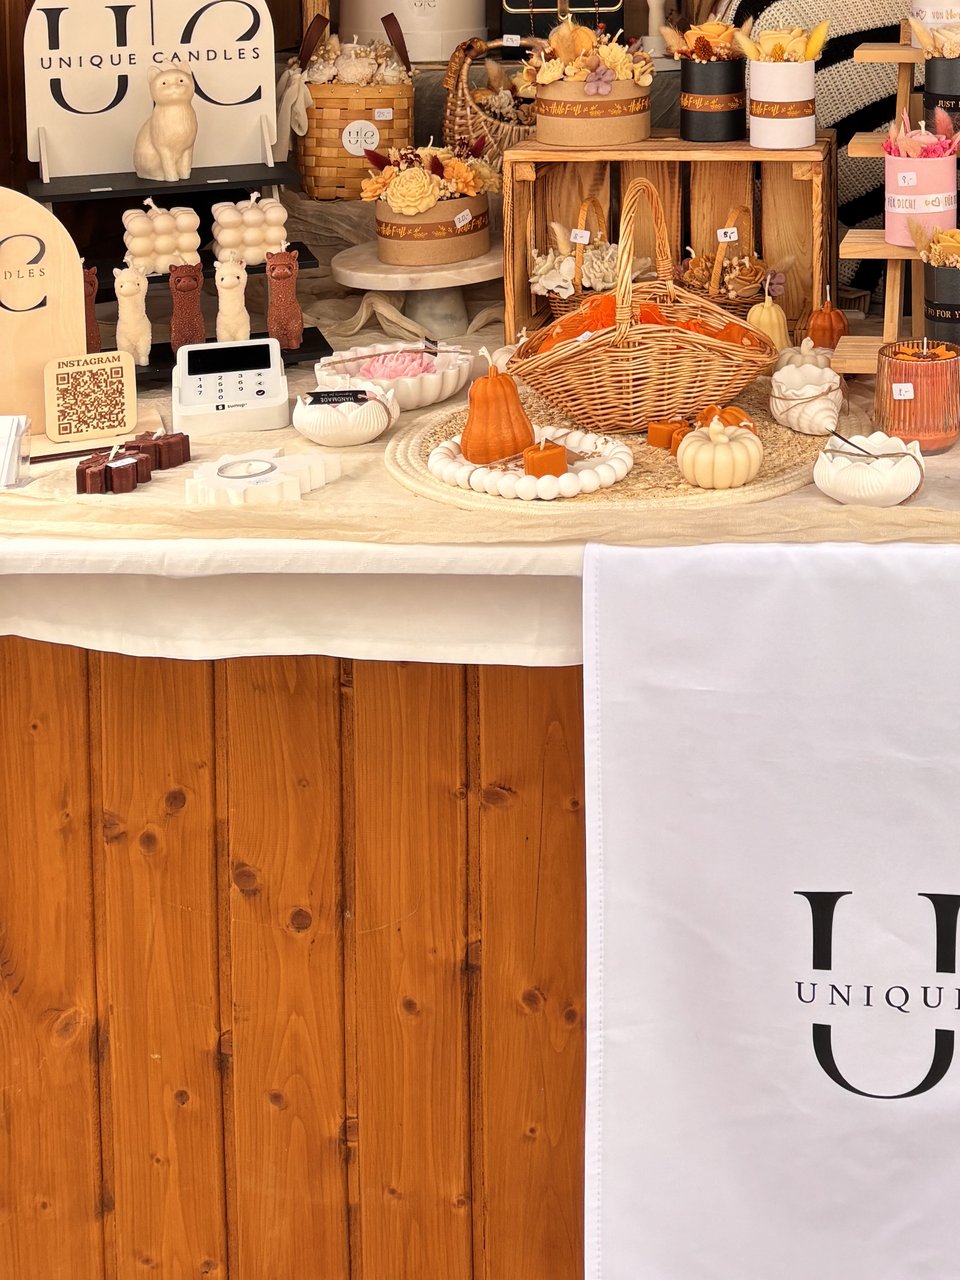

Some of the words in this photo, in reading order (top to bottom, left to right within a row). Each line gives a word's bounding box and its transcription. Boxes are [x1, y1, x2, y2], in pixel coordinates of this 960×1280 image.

[40, 53, 137, 70] UNIQUE
[152, 47, 260, 64] CANDLES
[937, 100, 956, 108] JUST
[936, 309, 951, 319] FOR
[57, 355, 121, 370] INSTAGRAM
